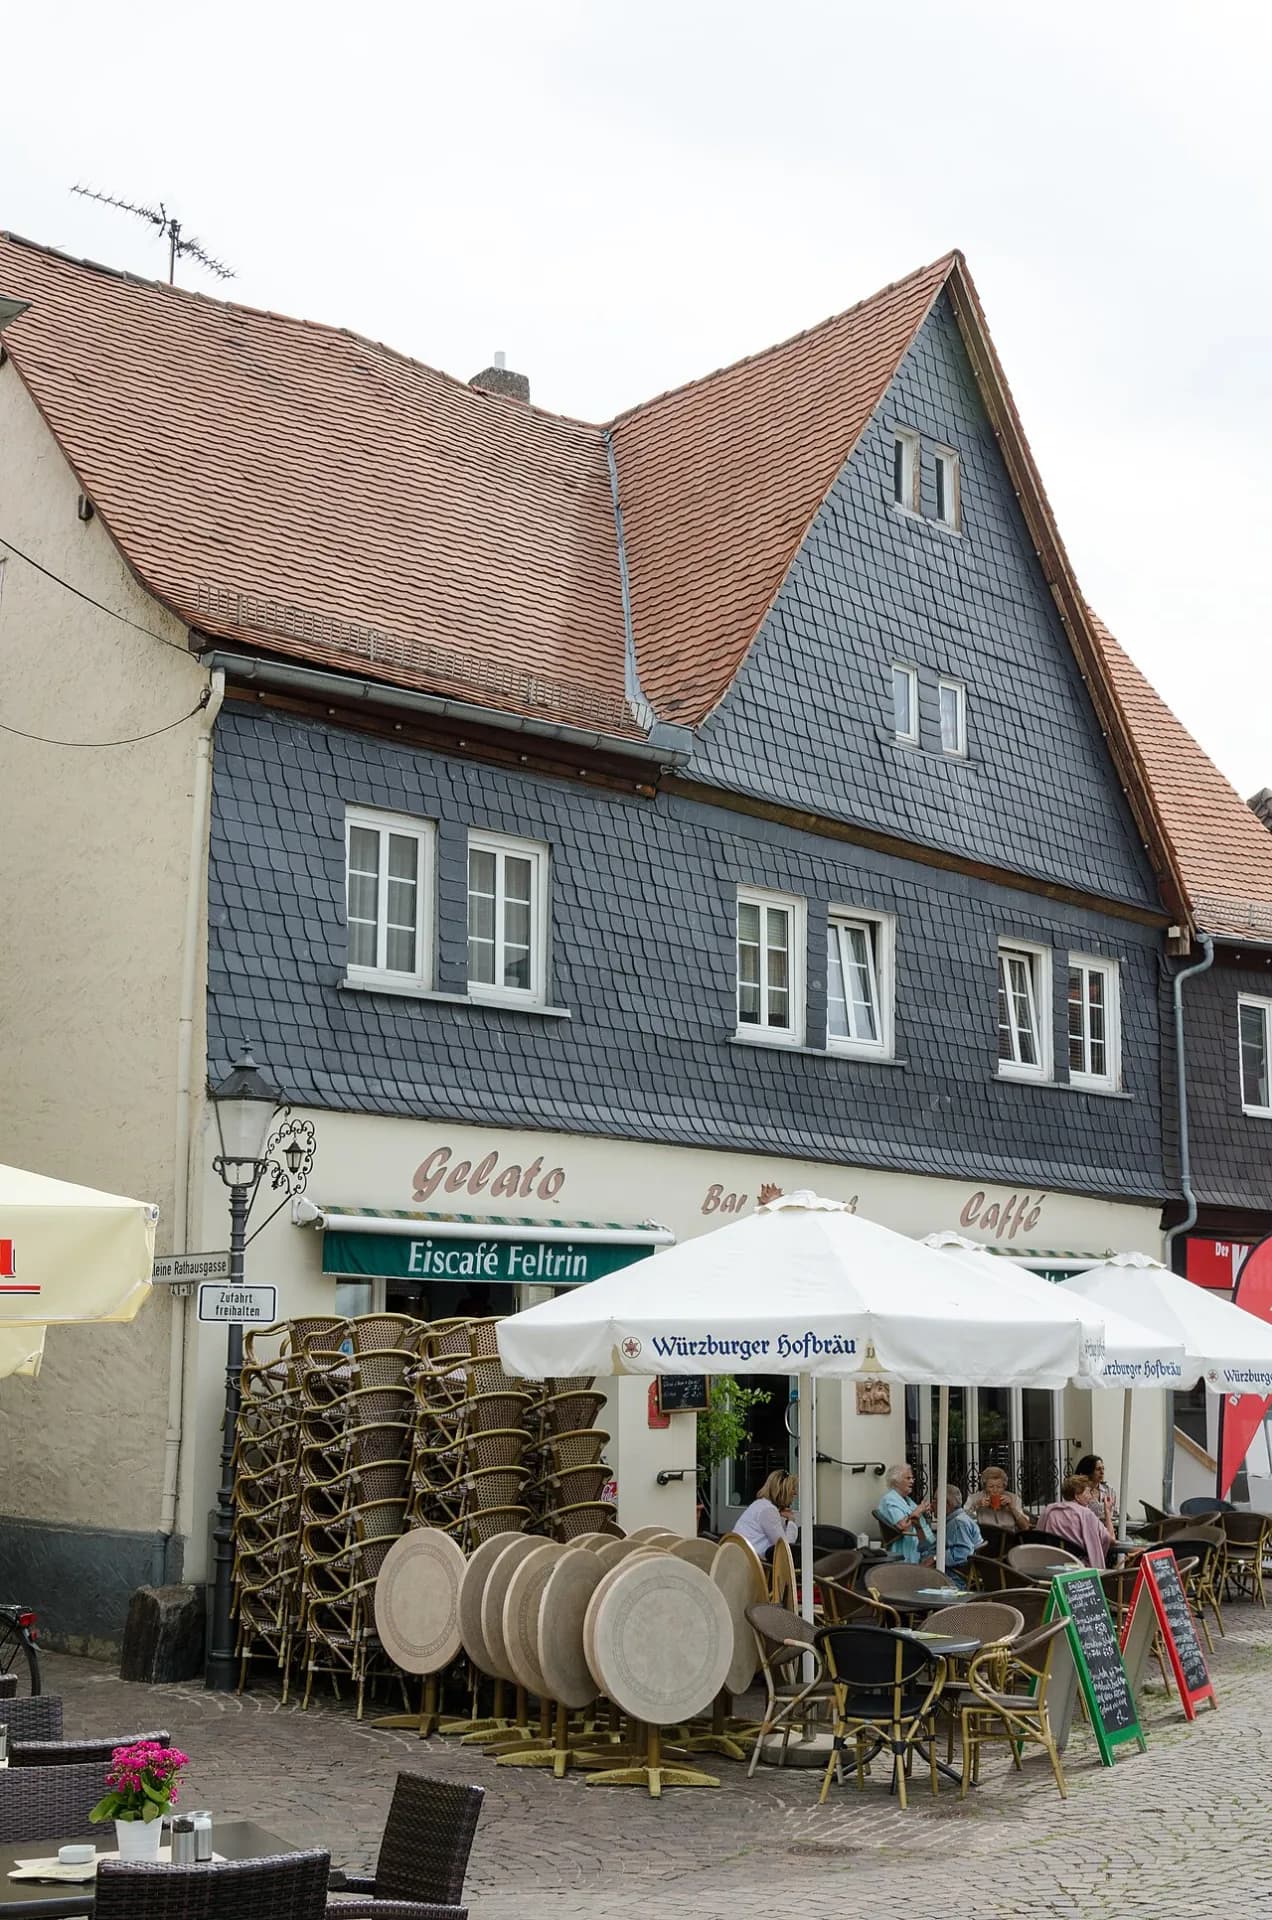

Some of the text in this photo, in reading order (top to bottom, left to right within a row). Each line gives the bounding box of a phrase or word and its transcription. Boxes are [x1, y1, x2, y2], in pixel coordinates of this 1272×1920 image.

[412, 1146, 566, 1202] Gelato
[701, 1183, 748, 1215] Bar
[959, 1191, 1046, 1239] Caffé
[152, 1260, 227, 1278] leine Rathausgasse
[408, 1240, 587, 1277] Eiscafé Feltrin
[220, 1291, 253, 1304] Zufahrt
[216, 1305, 261, 1317] freihalten
[652, 1331, 857, 1360] Würzburger Hofbräu
[1144, 1359, 1182, 1379] Hofbräu
[1223, 1368, 1272, 1386] Würzburg
